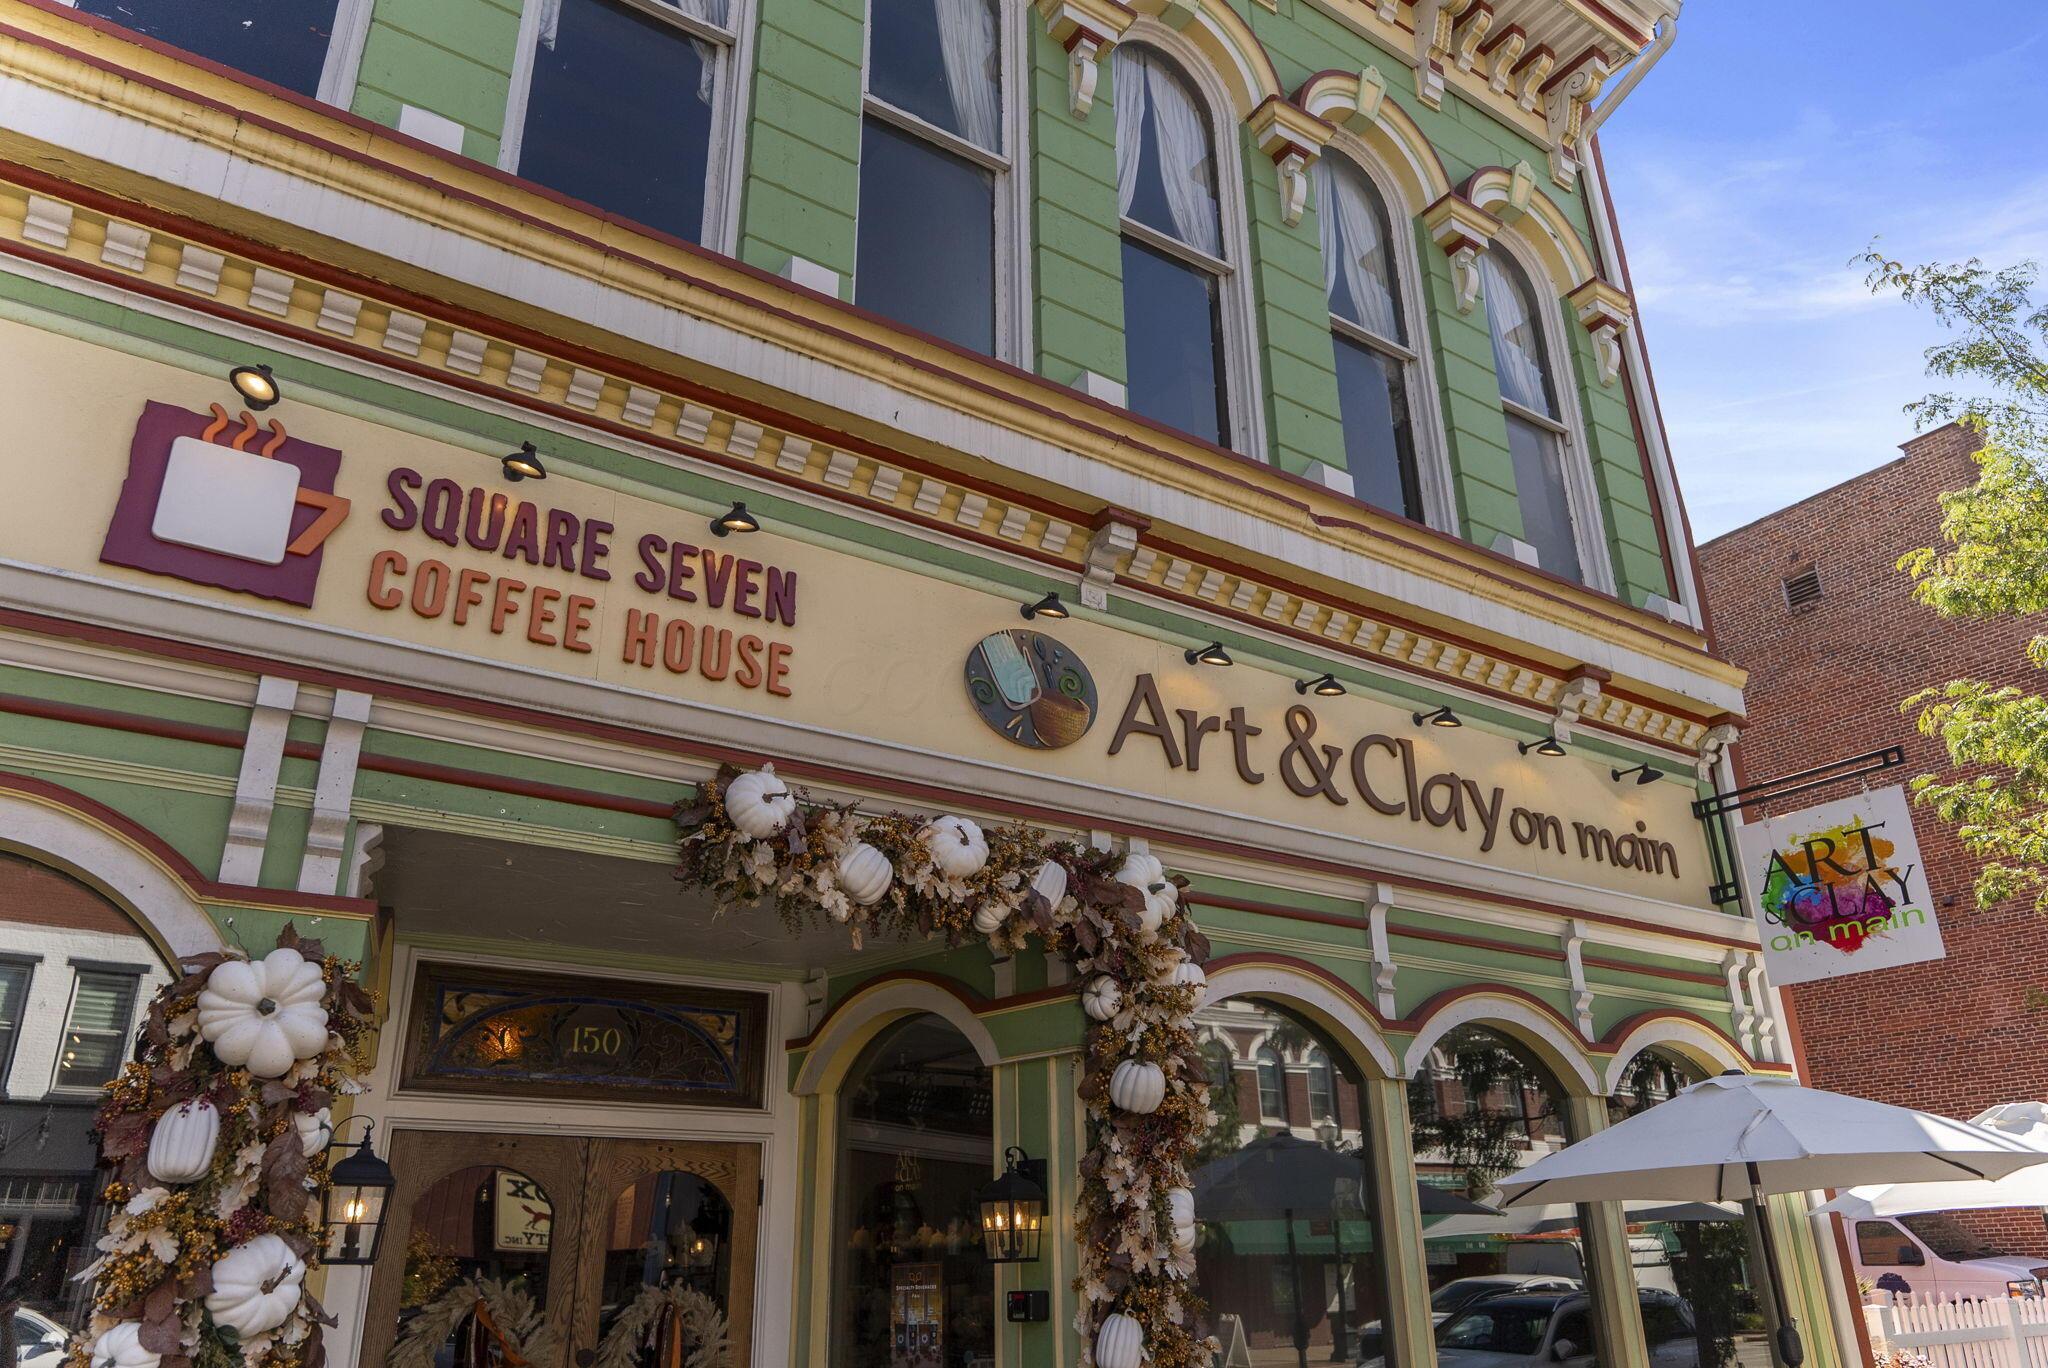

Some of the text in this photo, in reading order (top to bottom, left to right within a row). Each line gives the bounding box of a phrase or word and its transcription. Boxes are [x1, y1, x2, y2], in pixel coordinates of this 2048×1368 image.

[380, 467, 798, 627] SQUARE SEVEN
[367, 549, 794, 698] COFFEE HOUSE
[1107, 672, 1266, 785] Art
[1510, 806, 1567, 855] on
[1574, 820, 1680, 880] main
[1760, 820, 1886, 895] ART
[1790, 863, 1915, 925] CLAY
[1770, 907, 1926, 952] on main
[571, 1026, 621, 1055] 150
